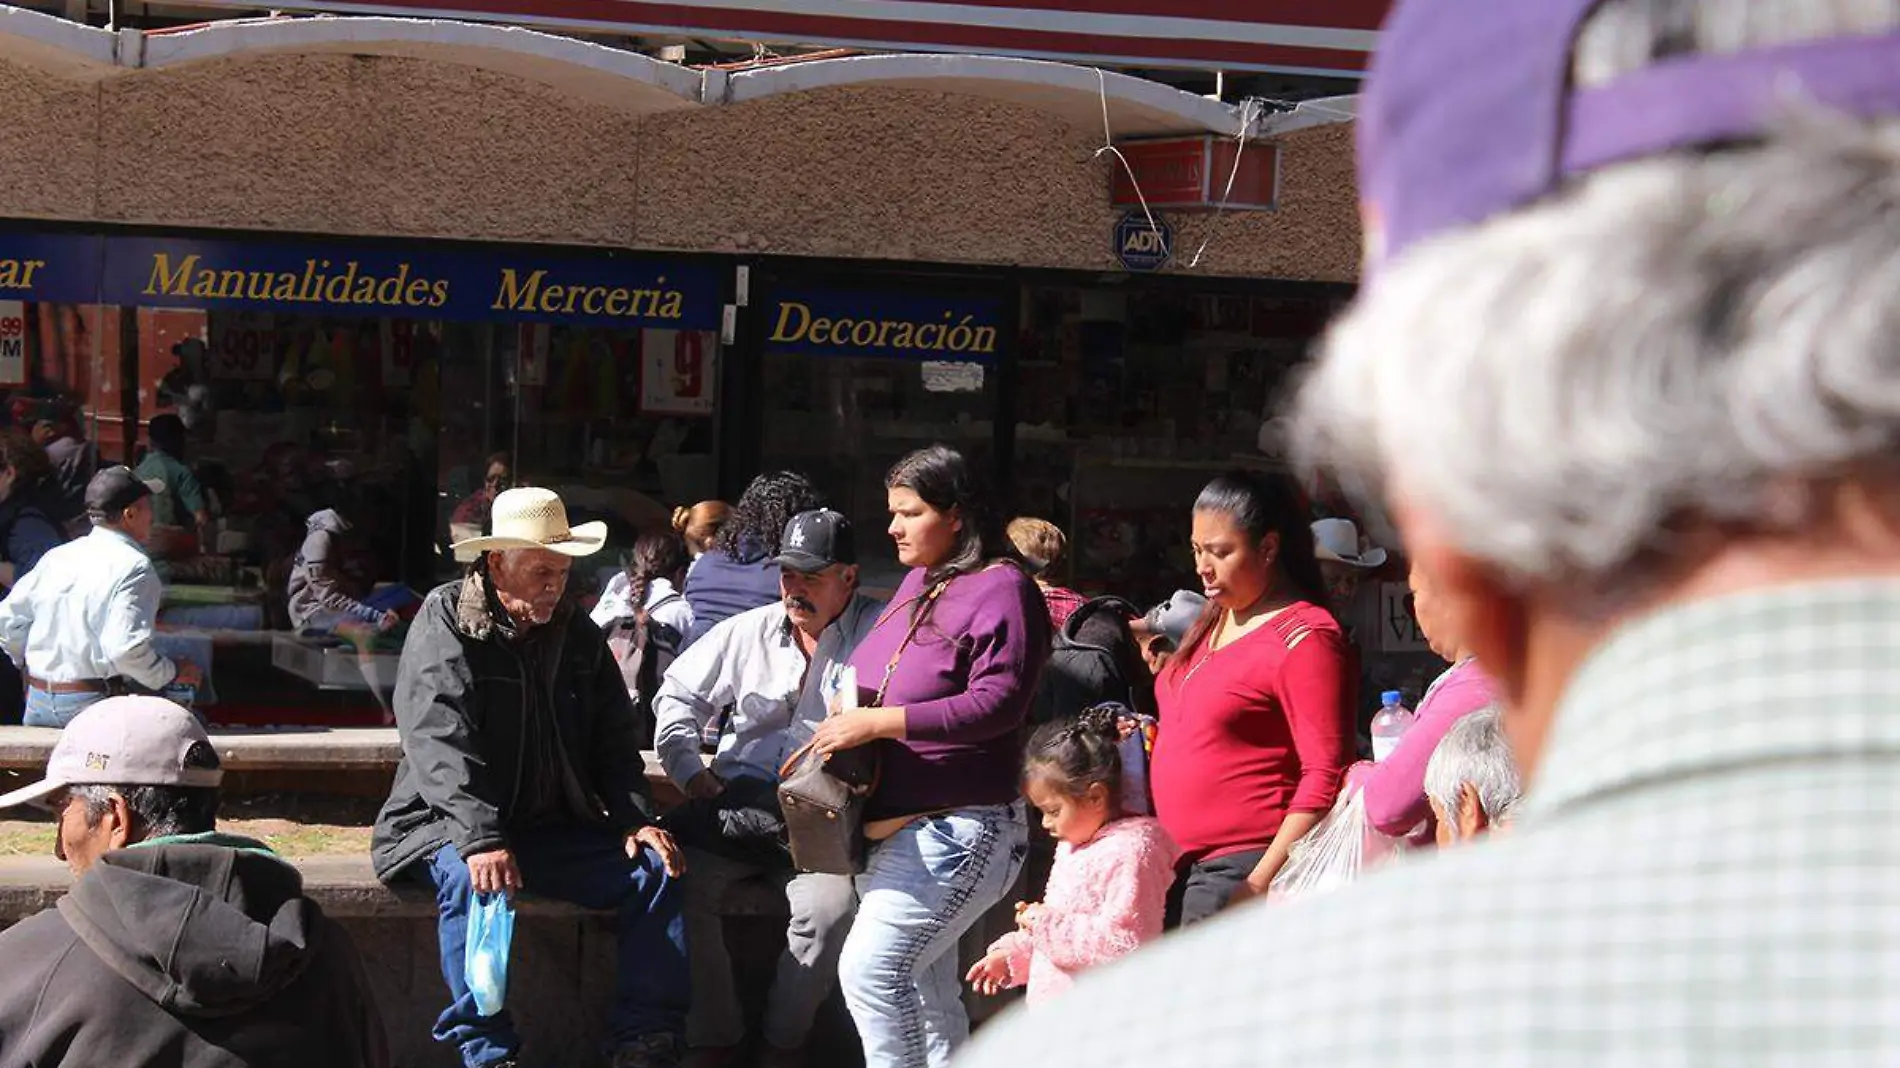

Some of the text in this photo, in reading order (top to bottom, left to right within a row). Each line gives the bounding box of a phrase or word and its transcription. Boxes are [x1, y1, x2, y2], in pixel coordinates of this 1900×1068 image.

[1125, 230, 1164, 254] ADT
[142, 253, 449, 308] Manualidades
[491, 268, 683, 320] Merceria
[1, 317, 22, 336] 99
[769, 302, 998, 354] Decoración
[789, 524, 807, 547] LA
[86, 751, 110, 770] CAT
